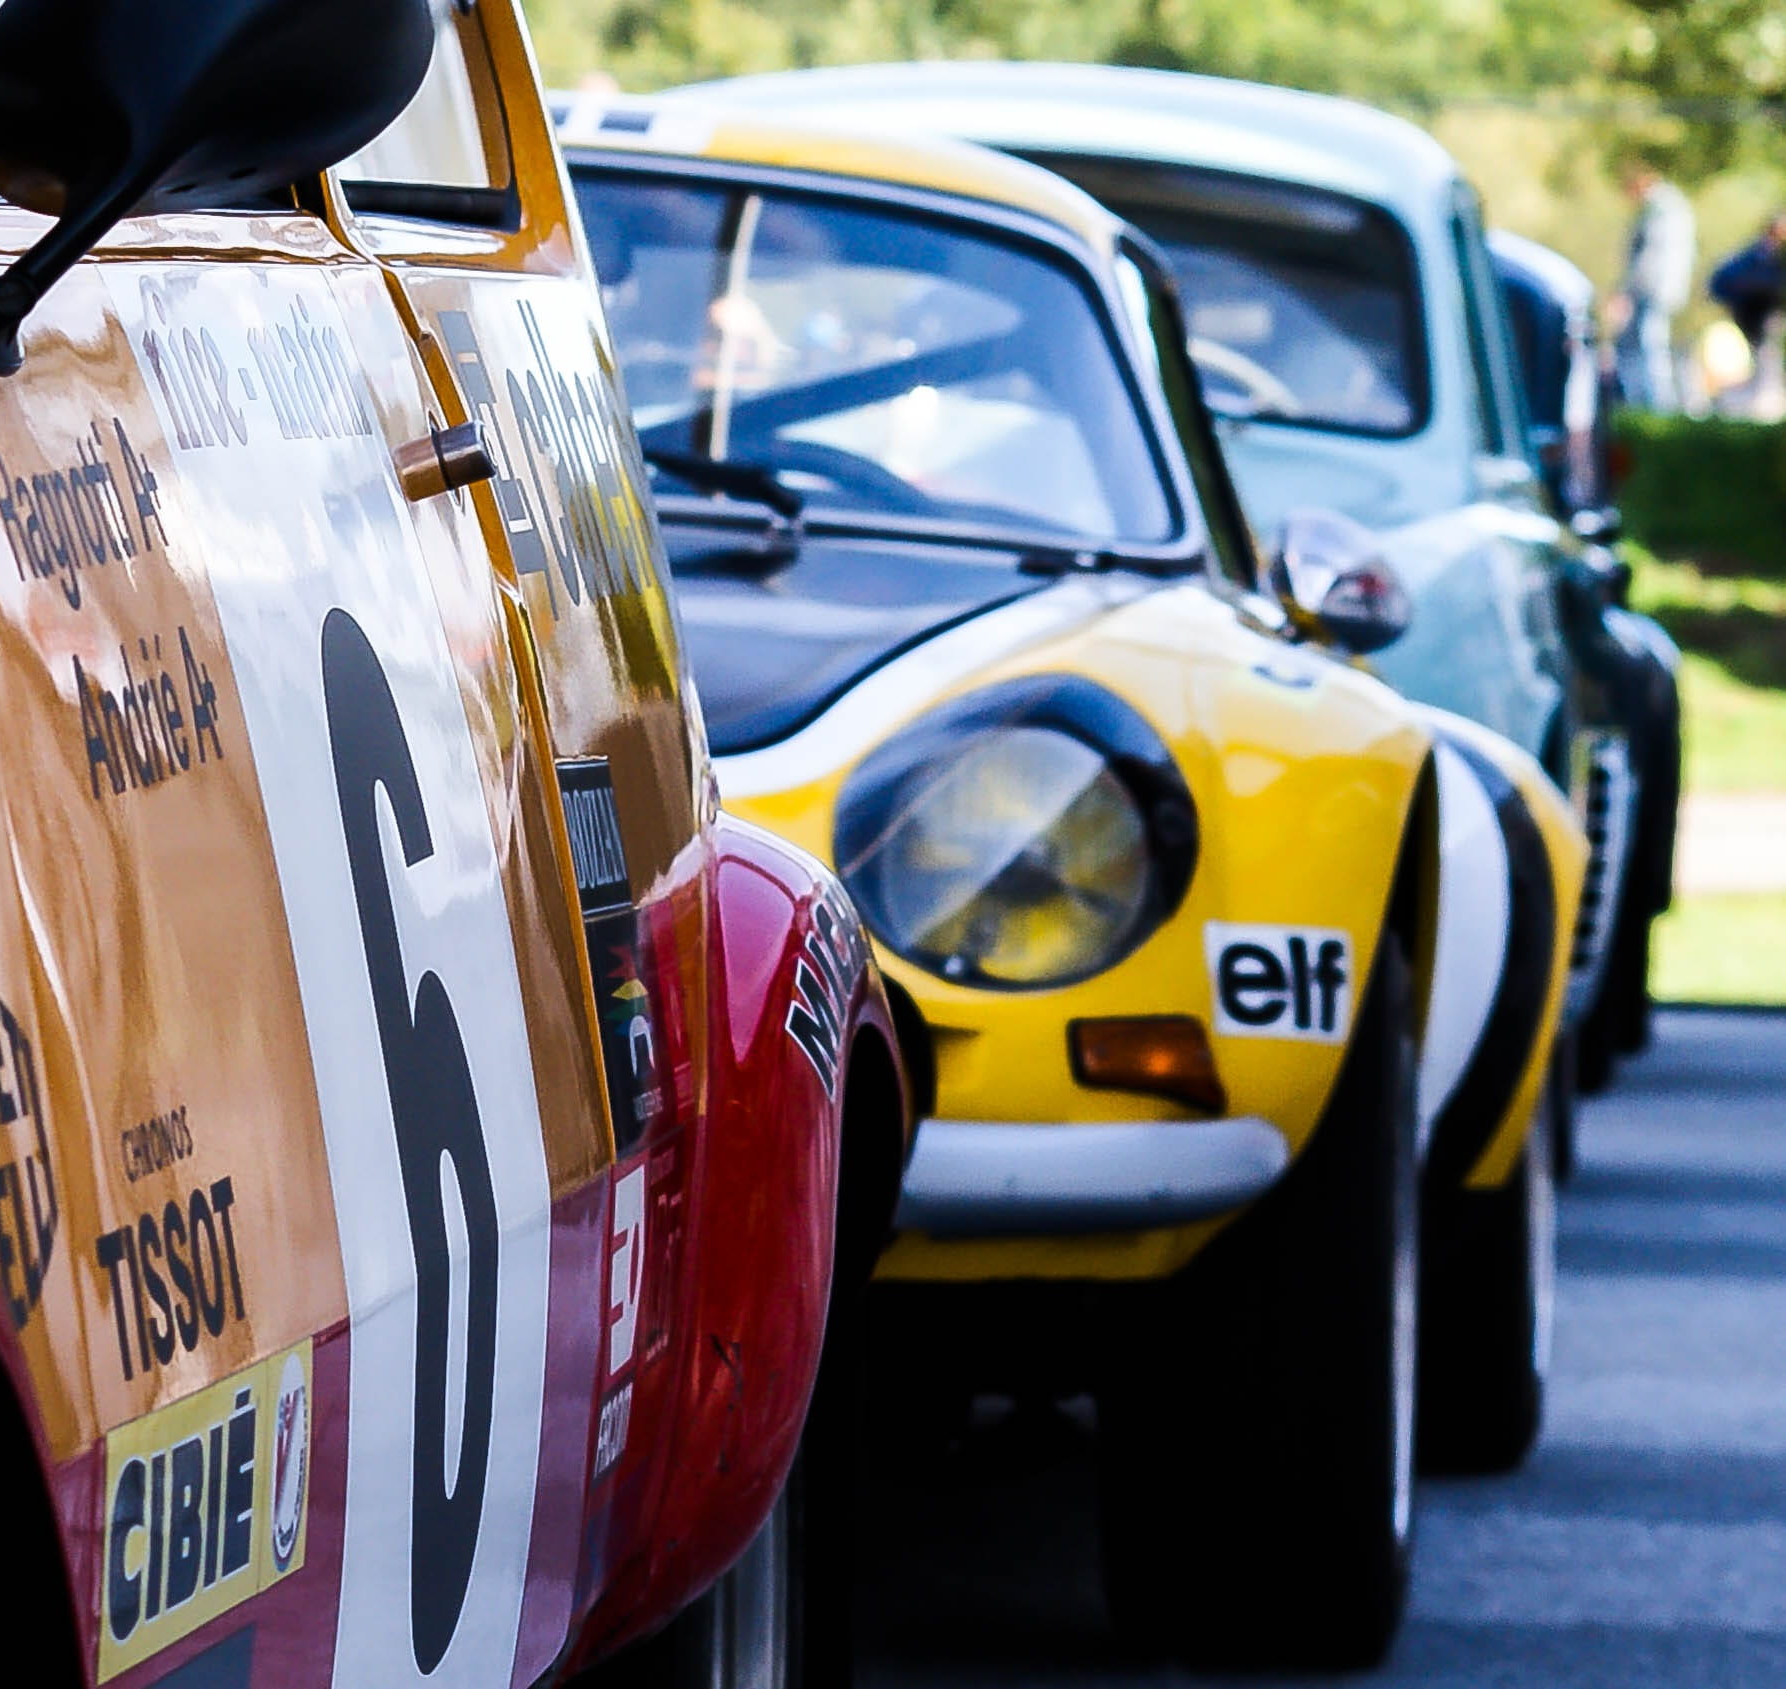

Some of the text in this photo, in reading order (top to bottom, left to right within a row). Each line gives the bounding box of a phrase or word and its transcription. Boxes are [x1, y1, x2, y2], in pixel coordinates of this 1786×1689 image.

[1217, 935, 1348, 1033] elf
[121, 1105, 196, 1183] CHRONOS
[321, 607, 500, 1674] 6
[97, 1175, 247, 1382] TISSOT
